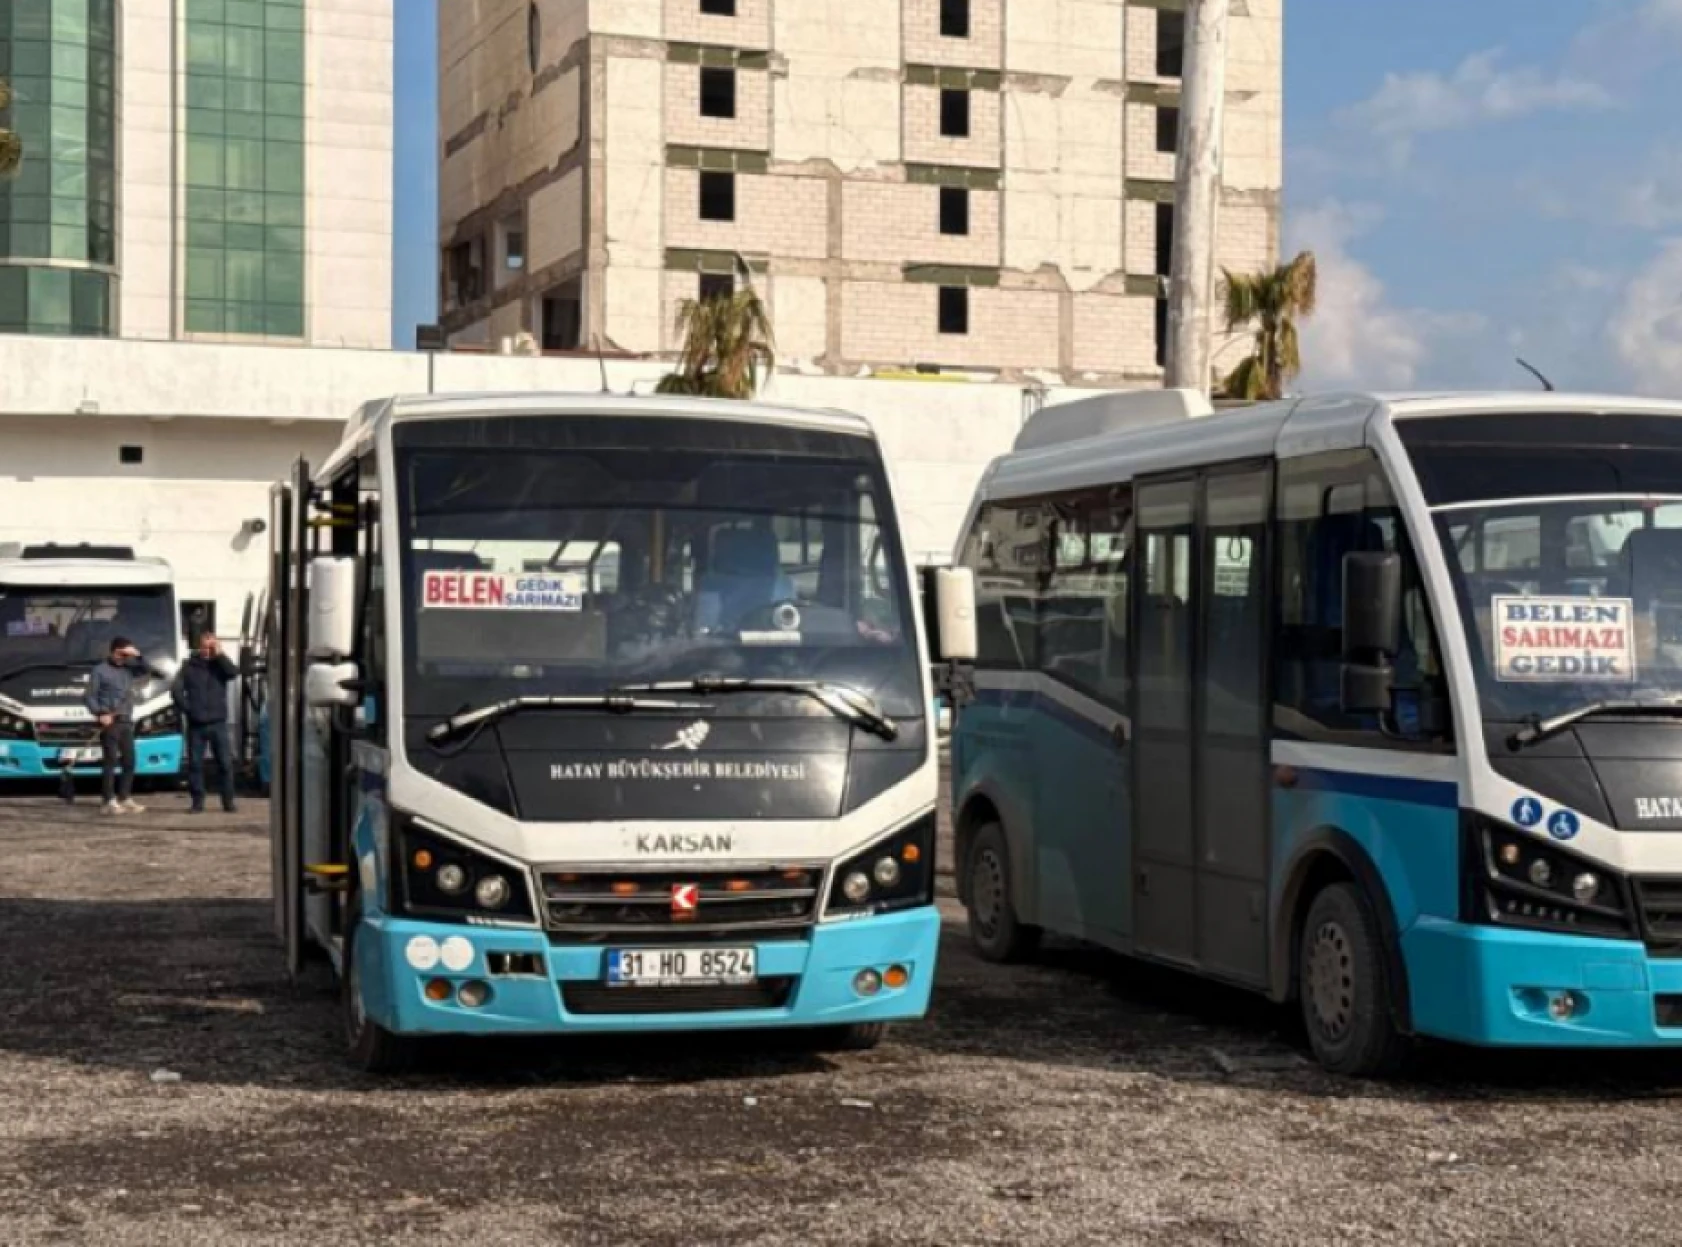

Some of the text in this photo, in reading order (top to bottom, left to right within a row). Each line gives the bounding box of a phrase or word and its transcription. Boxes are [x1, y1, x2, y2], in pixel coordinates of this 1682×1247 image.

[425, 575, 503, 605] BELEN
[1506, 604, 1619, 623] BELEN
[1502, 626, 1625, 650] SARIMAZI
[1510, 650, 1622, 675] GEDİK
[549, 758, 806, 781] HATAY BÜYÜKŞEHİR BELEDİYESİ
[636, 833, 733, 854] KARSAN
[622, 952, 643, 976] 31
[700, 952, 752, 976] 8524
